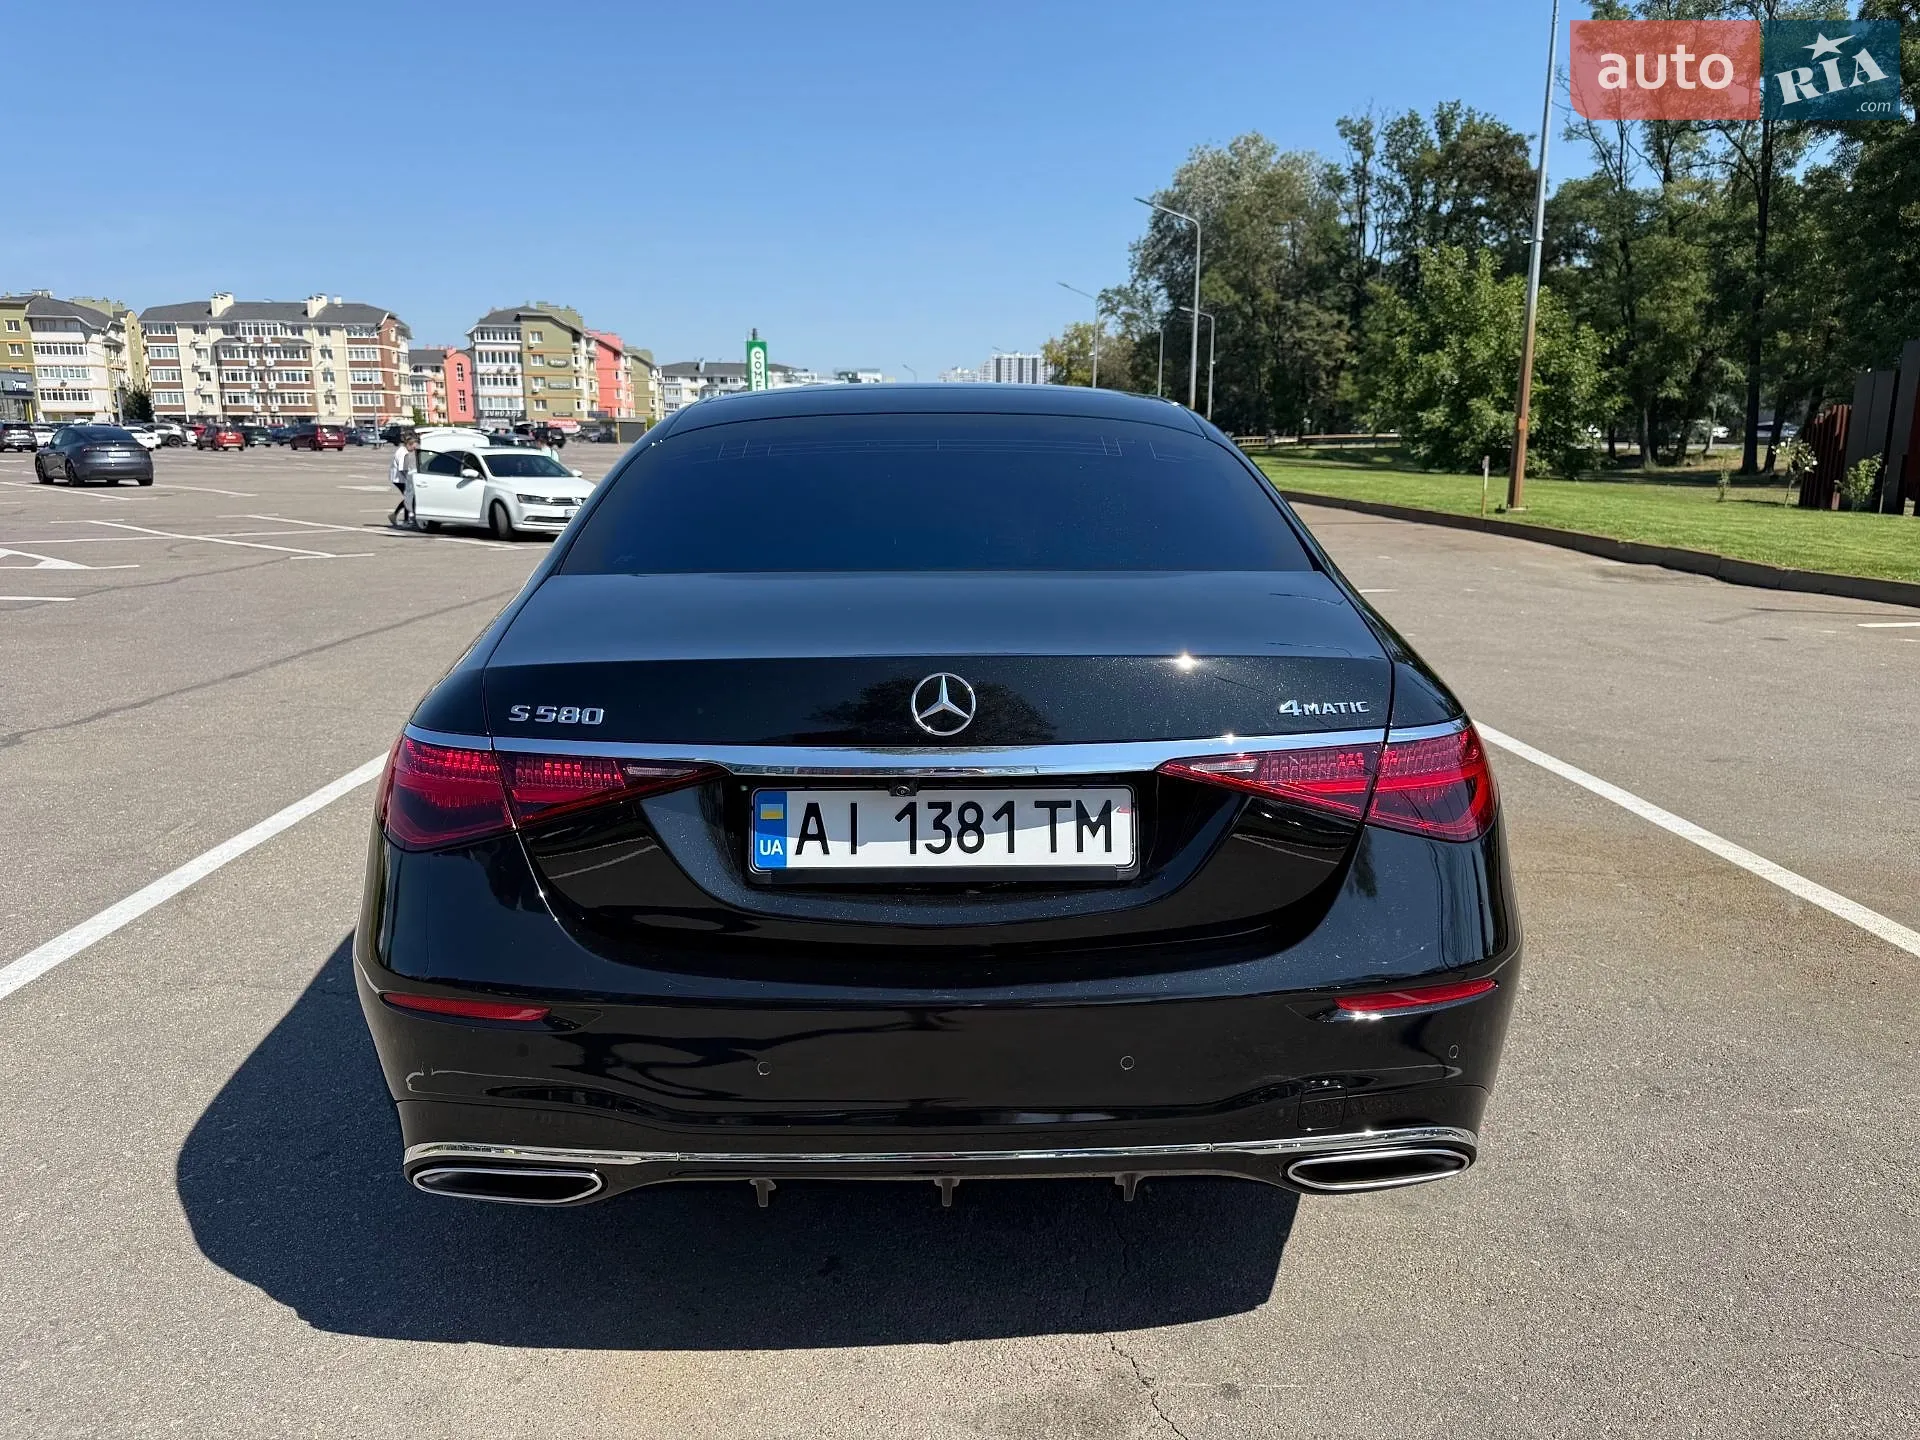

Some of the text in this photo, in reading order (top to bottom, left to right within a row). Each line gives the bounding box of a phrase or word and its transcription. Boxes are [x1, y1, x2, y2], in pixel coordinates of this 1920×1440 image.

[508, 704, 605, 725] S 580
[1278, 699, 1370, 716] 4MATIC
[794, 799, 1113, 856] AI 1381 TM
[759, 839, 784, 856] UA
